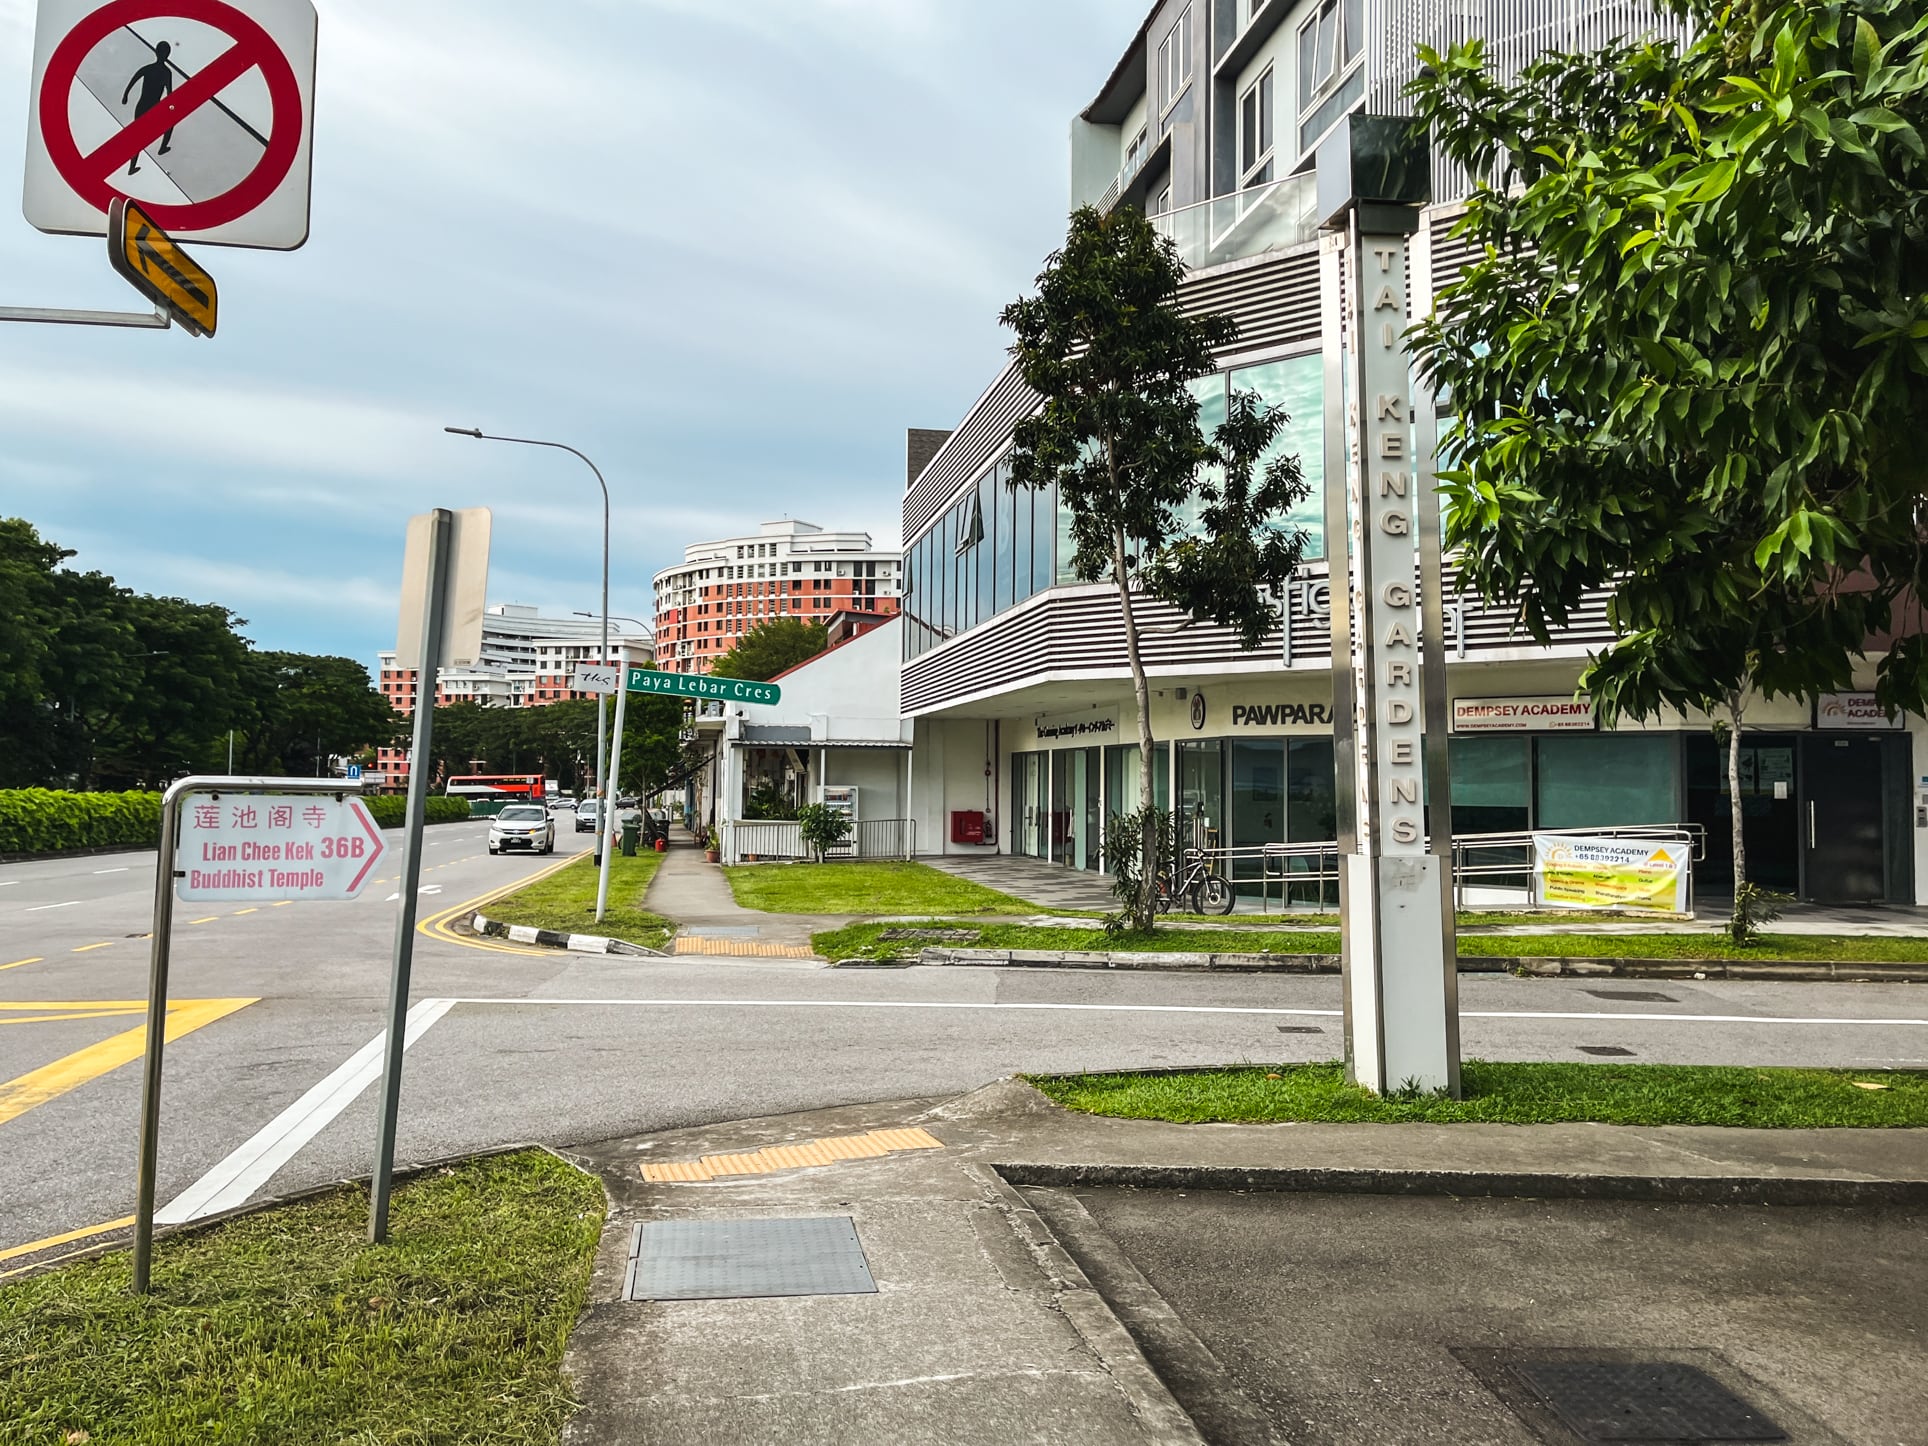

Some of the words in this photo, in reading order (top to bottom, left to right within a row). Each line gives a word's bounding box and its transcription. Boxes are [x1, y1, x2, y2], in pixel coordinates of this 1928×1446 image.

[1374, 248, 1399, 349] TAI
[1377, 393, 1409, 537] KENG
[632, 672, 671, 690] Paya
[678, 676, 727, 696] Lebar
[734, 682, 771, 700] Cres
[1382, 581, 1417, 844] GARDENS
[1456, 705, 1519, 717] DEMPSEY
[1520, 703, 1591, 716] ACADEMY
[193, 804, 327, 829] 莲池阁寺
[202, 841, 237, 861] Lian
[241, 841, 280, 861] Chee
[284, 840, 315, 860] Kek
[320, 836, 365, 859] 36B
[1574, 844, 1611, 854] DEMPSEY
[1610, 847, 1649, 856] ACADEMY
[190, 869, 264, 889] Buddhist
[267, 868, 324, 890] Temple
